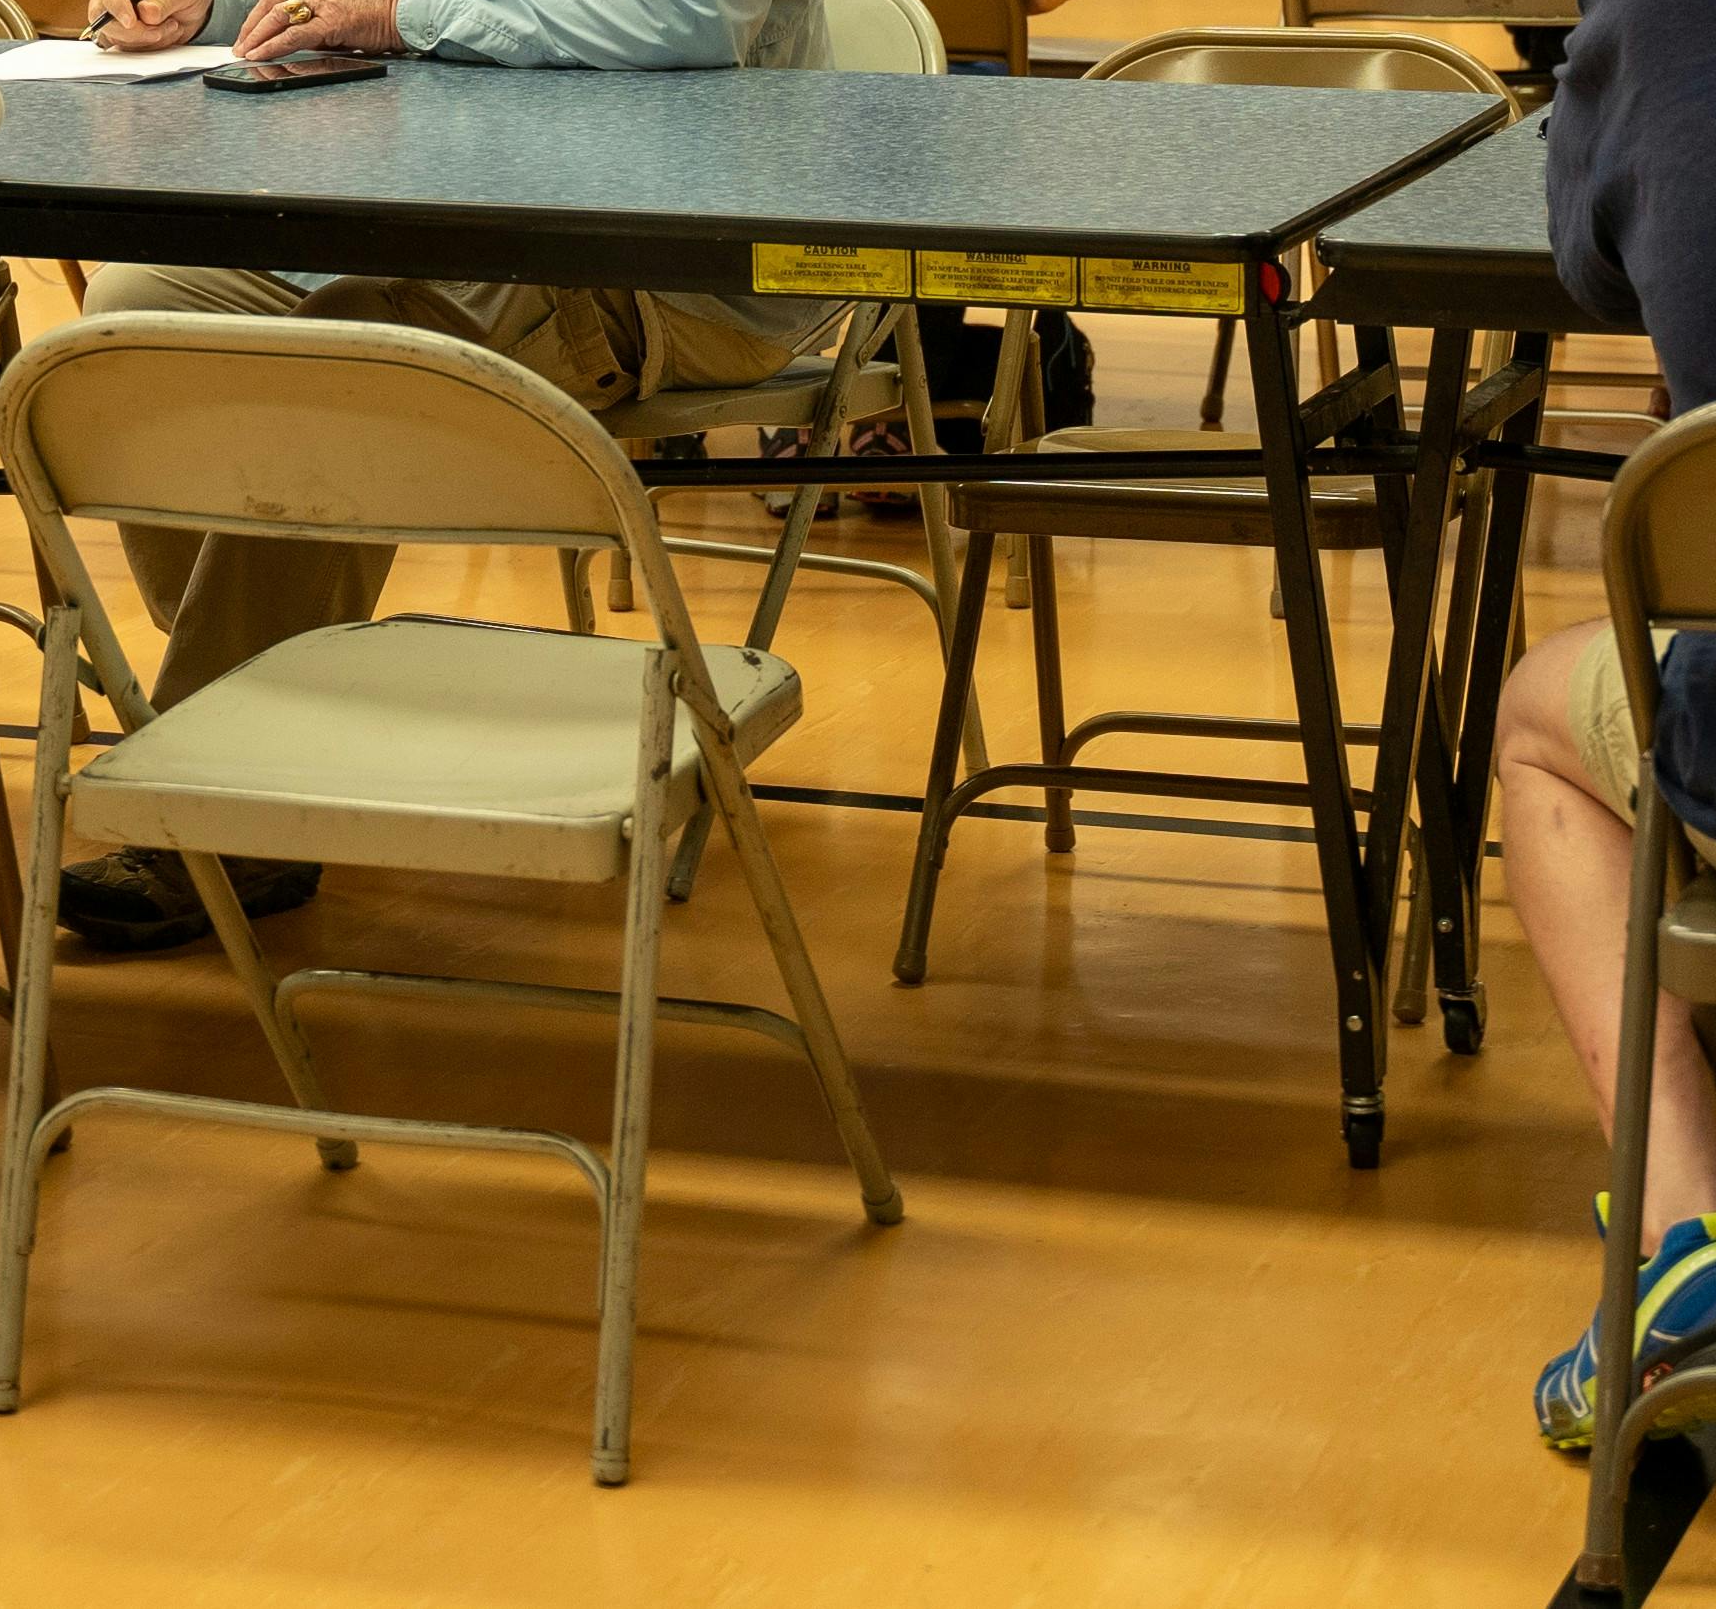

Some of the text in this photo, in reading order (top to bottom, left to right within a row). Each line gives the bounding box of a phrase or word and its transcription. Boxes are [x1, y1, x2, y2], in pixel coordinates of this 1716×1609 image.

[804, 245, 858, 255] CAUTION
[966, 251, 1027, 263] WARNING!
[1133, 260, 1191, 271] WARNING
[794, 270, 832, 278] OPERATING
